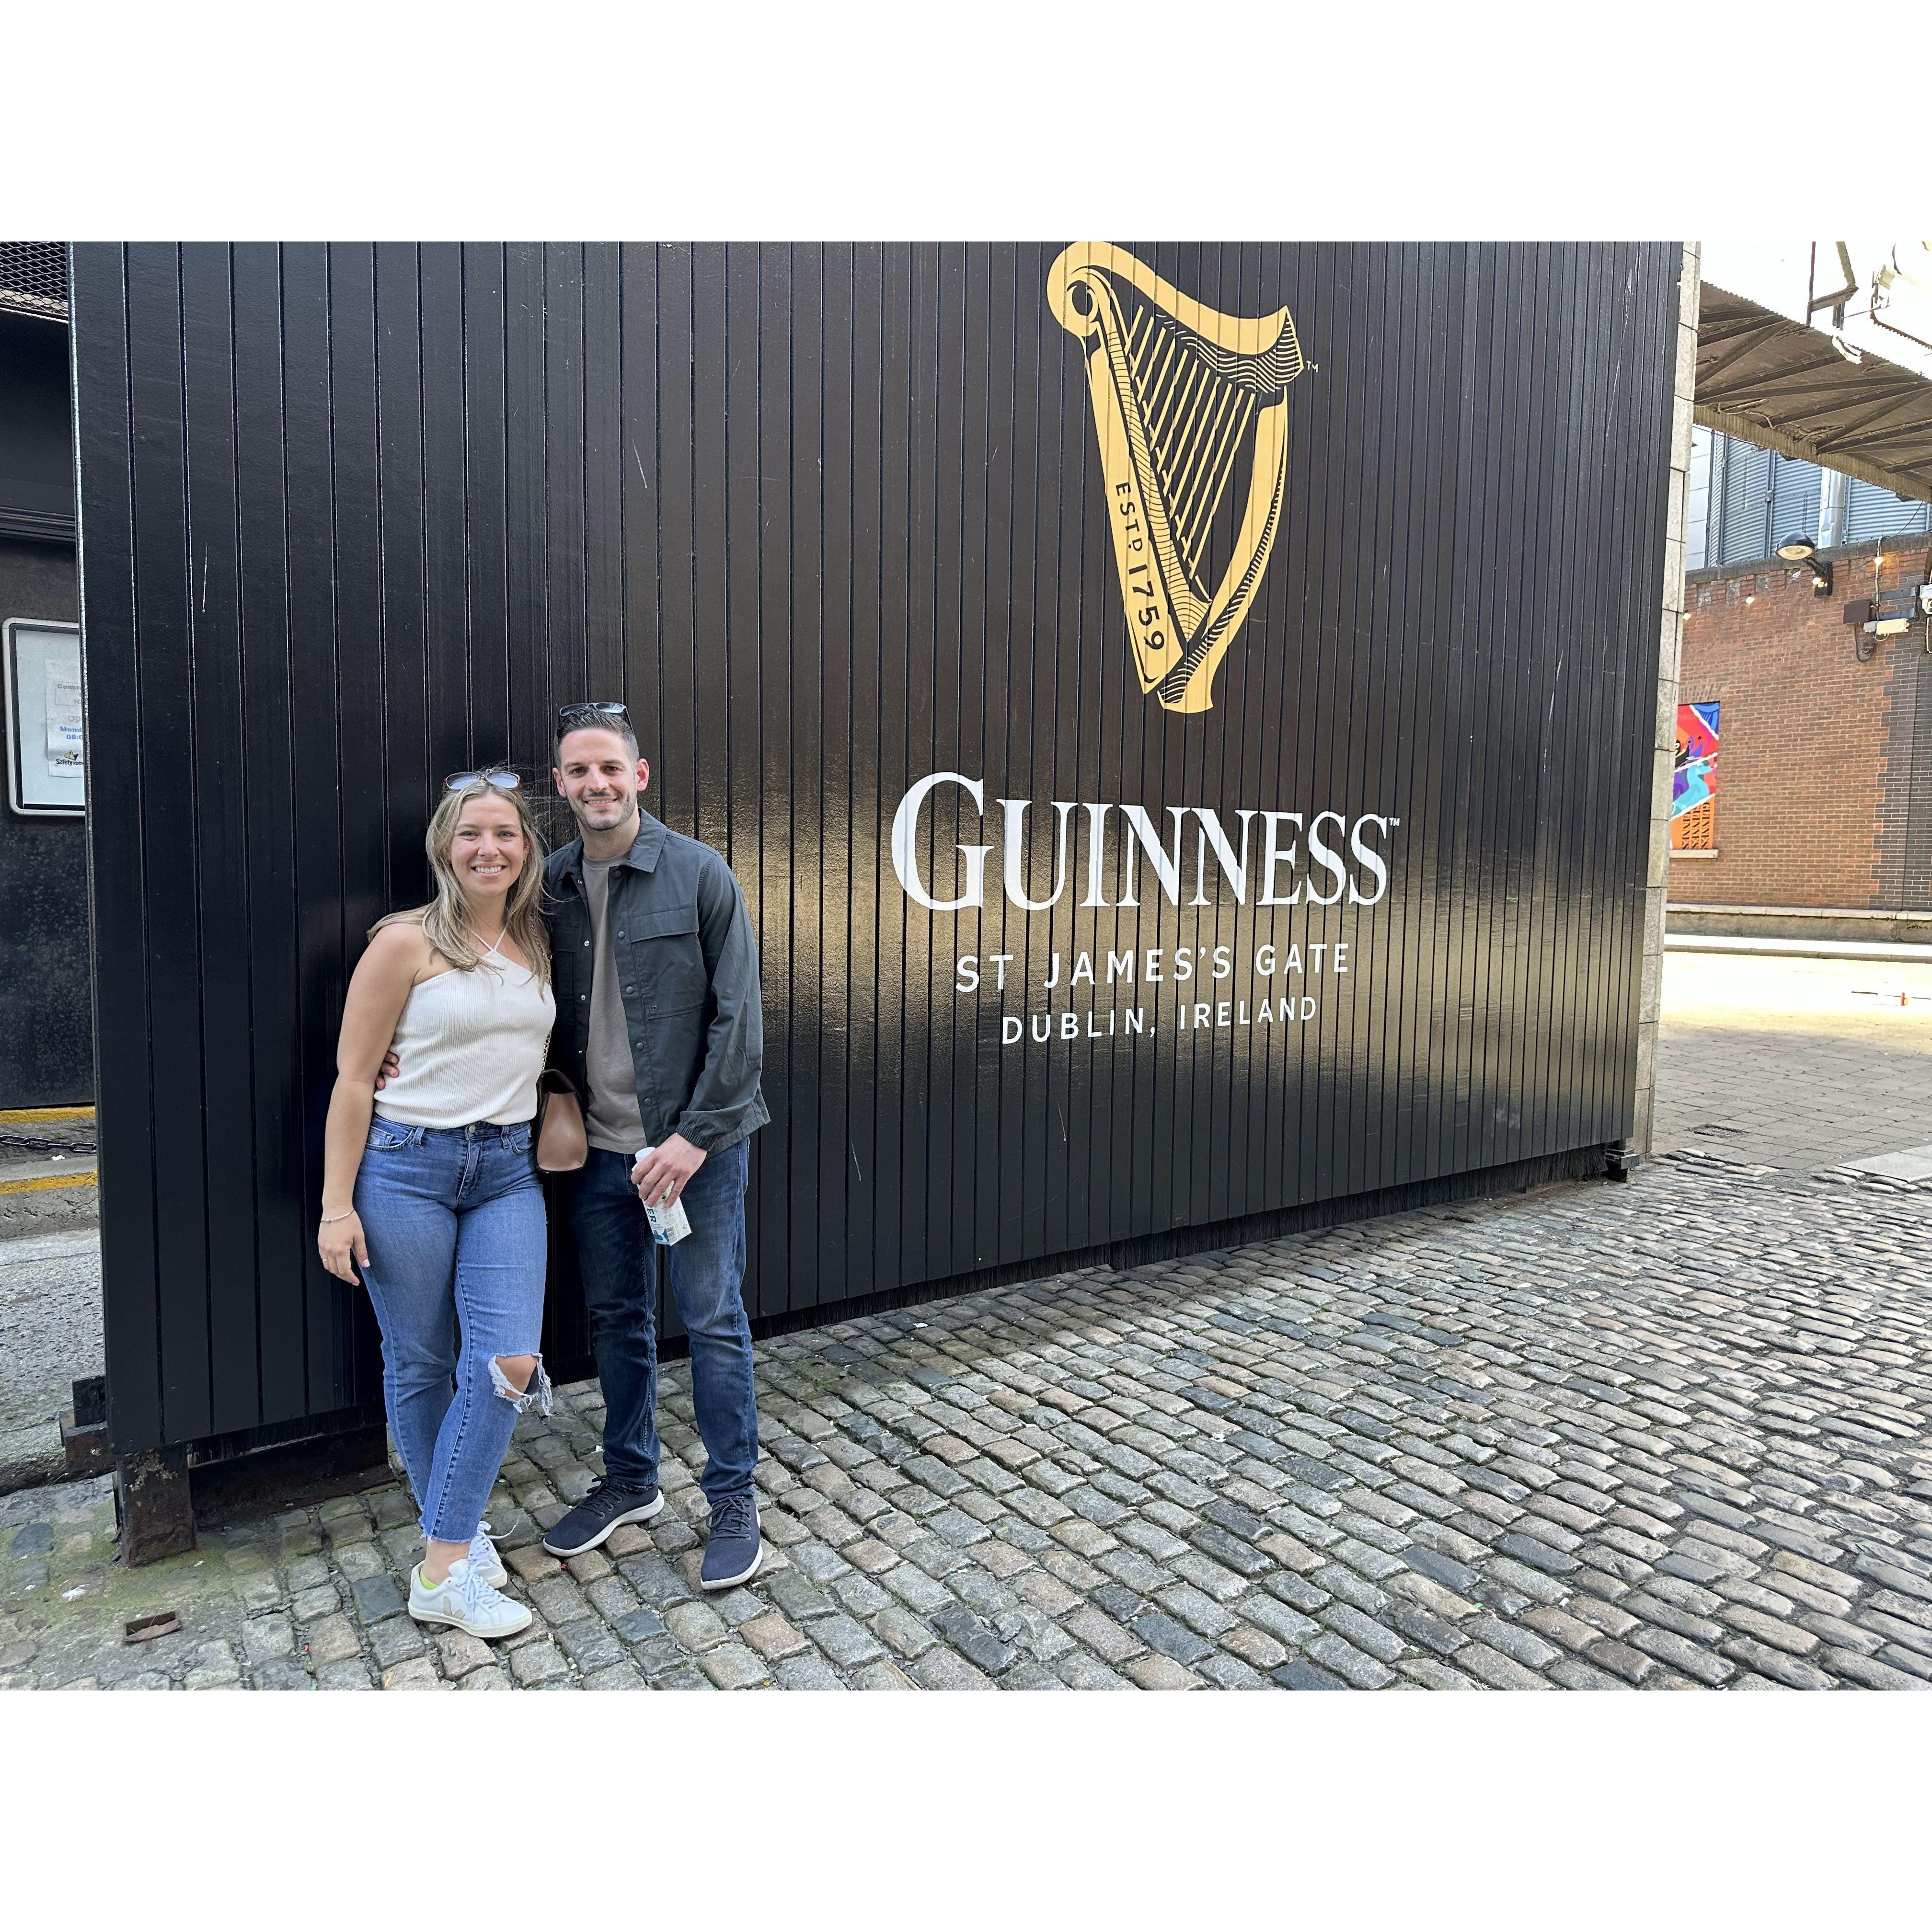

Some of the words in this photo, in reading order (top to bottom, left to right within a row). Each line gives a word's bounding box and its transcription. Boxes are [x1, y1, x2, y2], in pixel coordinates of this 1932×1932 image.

[1128, 564, 1164, 650] 1759
[891, 772, 1387, 911] GUINNESS
[1701, 802, 1711, 850] GUINNES
[955, 954, 1014, 993] ST
[1043, 946, 1231, 989] JAMES'S
[1255, 943, 1349, 976] GATE
[1002, 1007, 1155, 1044] DUBLIN,
[1180, 996, 1316, 1030] IRELAND
